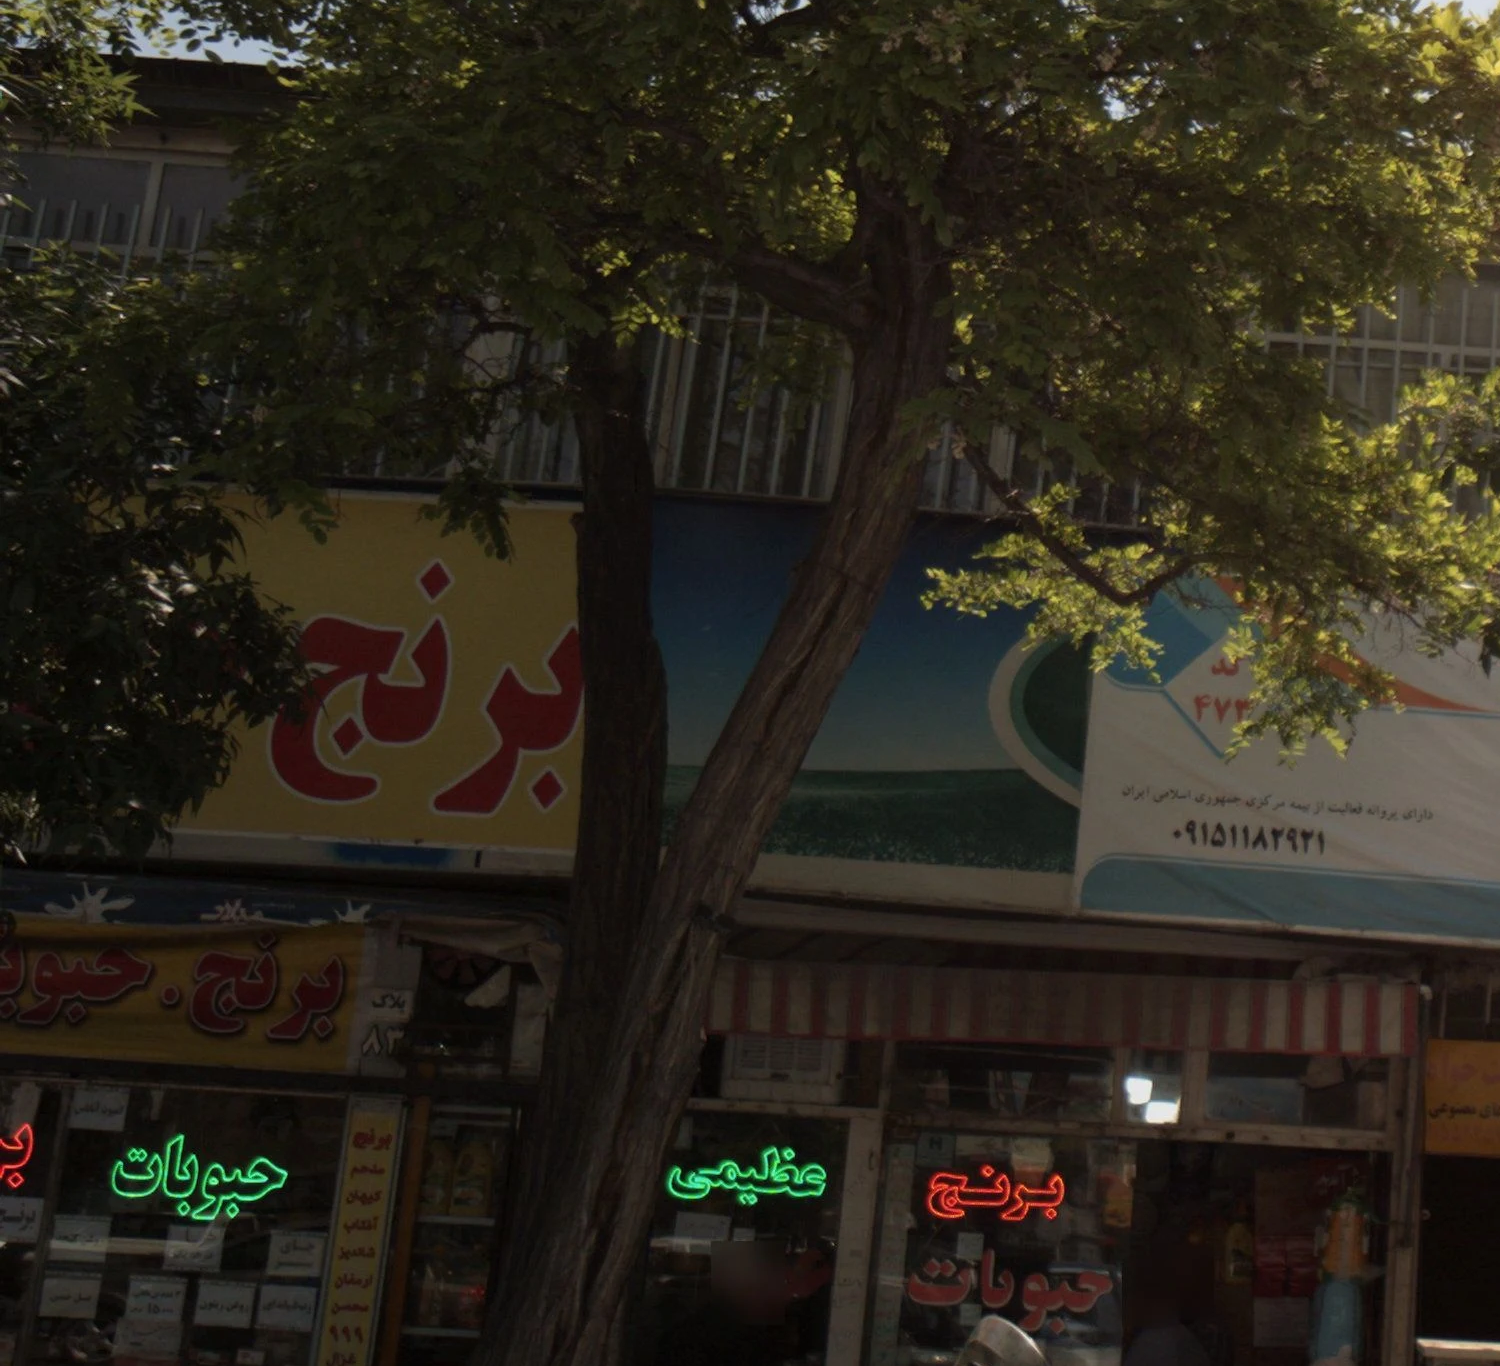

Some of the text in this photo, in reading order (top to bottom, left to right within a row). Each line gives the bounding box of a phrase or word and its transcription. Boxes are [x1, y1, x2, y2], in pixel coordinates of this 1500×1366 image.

[271, 559, 583, 818] برنج
[1122, 785, 1434, 823] دارای پروانه فعالیت از بیمه مرکزی جمهوری اسلامی ایران
[190, 931, 344, 1040] برنج
[108, 1132, 290, 1222] حبوبات
[664, 1144, 828, 1207] عظیمی
[926, 1163, 1067, 1222] برنج
[906, 1248, 1114, 1335] حبوبات
